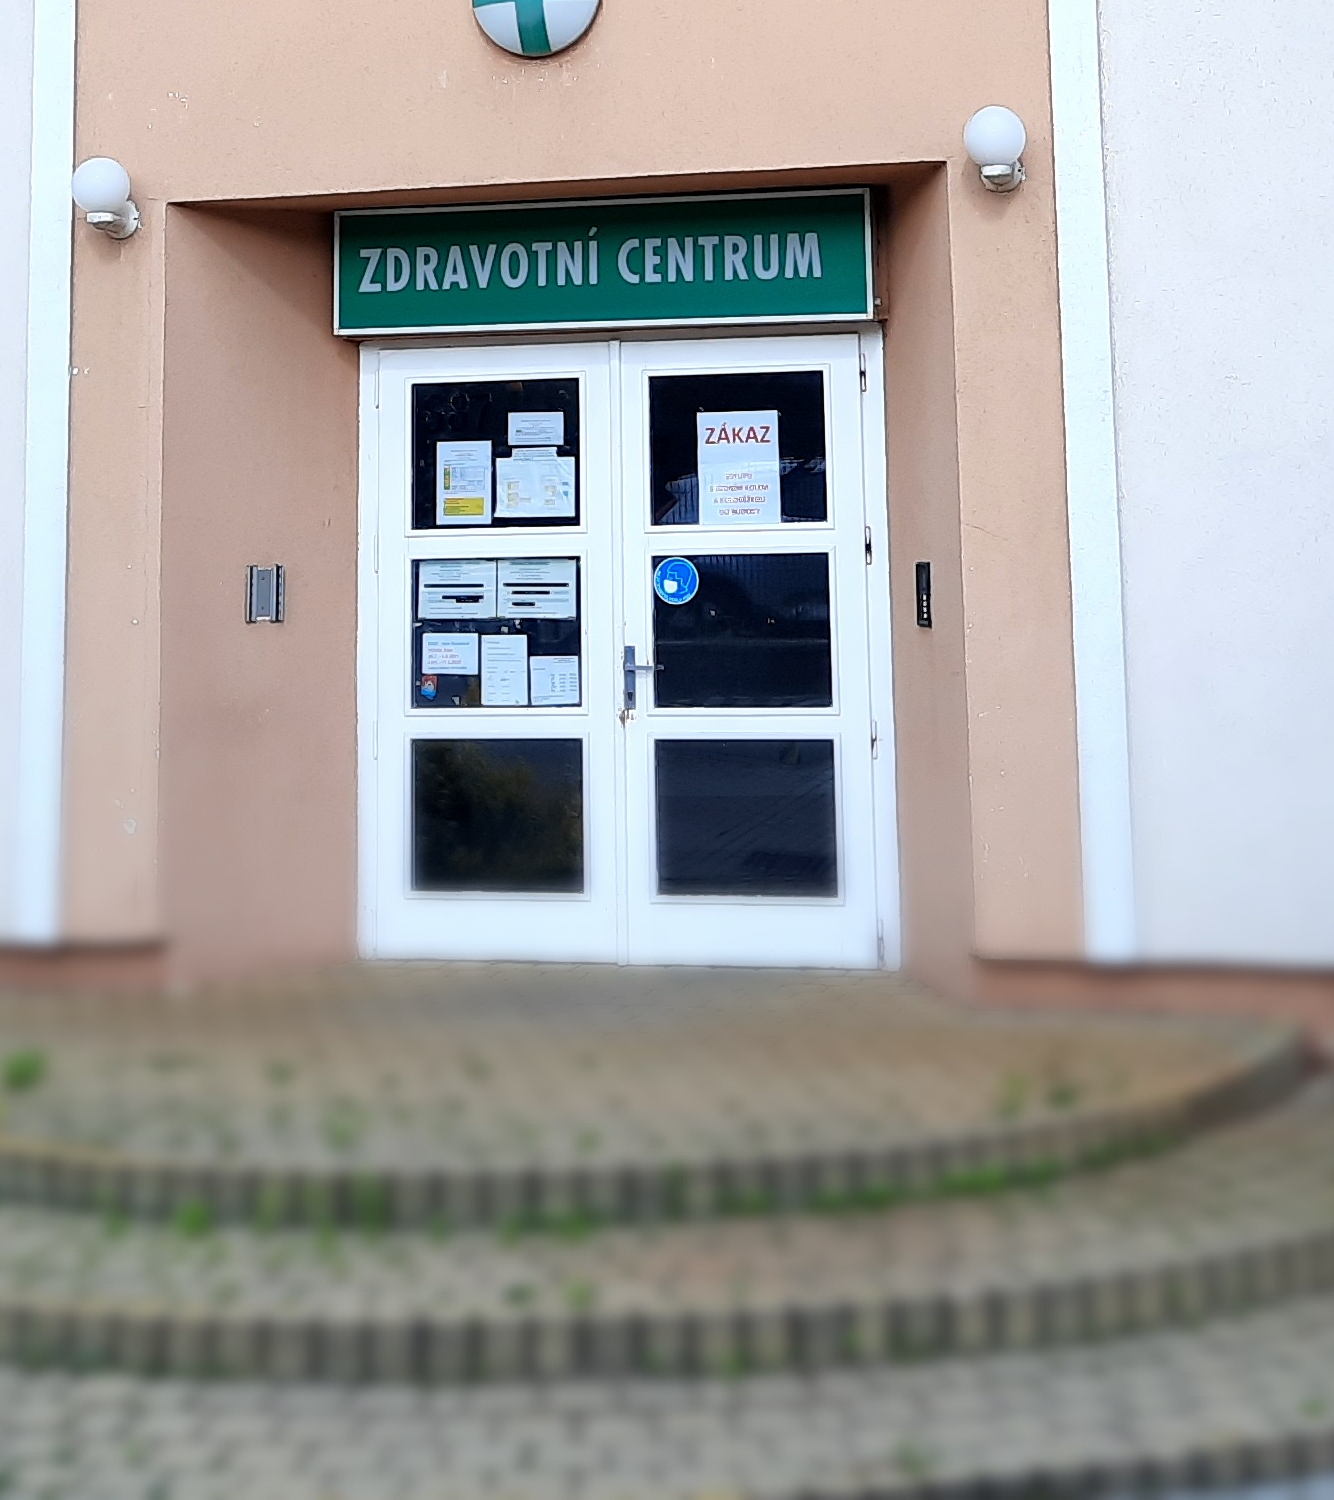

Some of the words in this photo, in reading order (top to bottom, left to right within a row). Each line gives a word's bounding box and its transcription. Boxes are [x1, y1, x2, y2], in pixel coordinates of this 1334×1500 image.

[358, 227, 599, 293] ZDRAVOTNÍ
[618, 232, 823, 284] CENTRUM
[704, 422, 771, 444] ZÁKAZ
